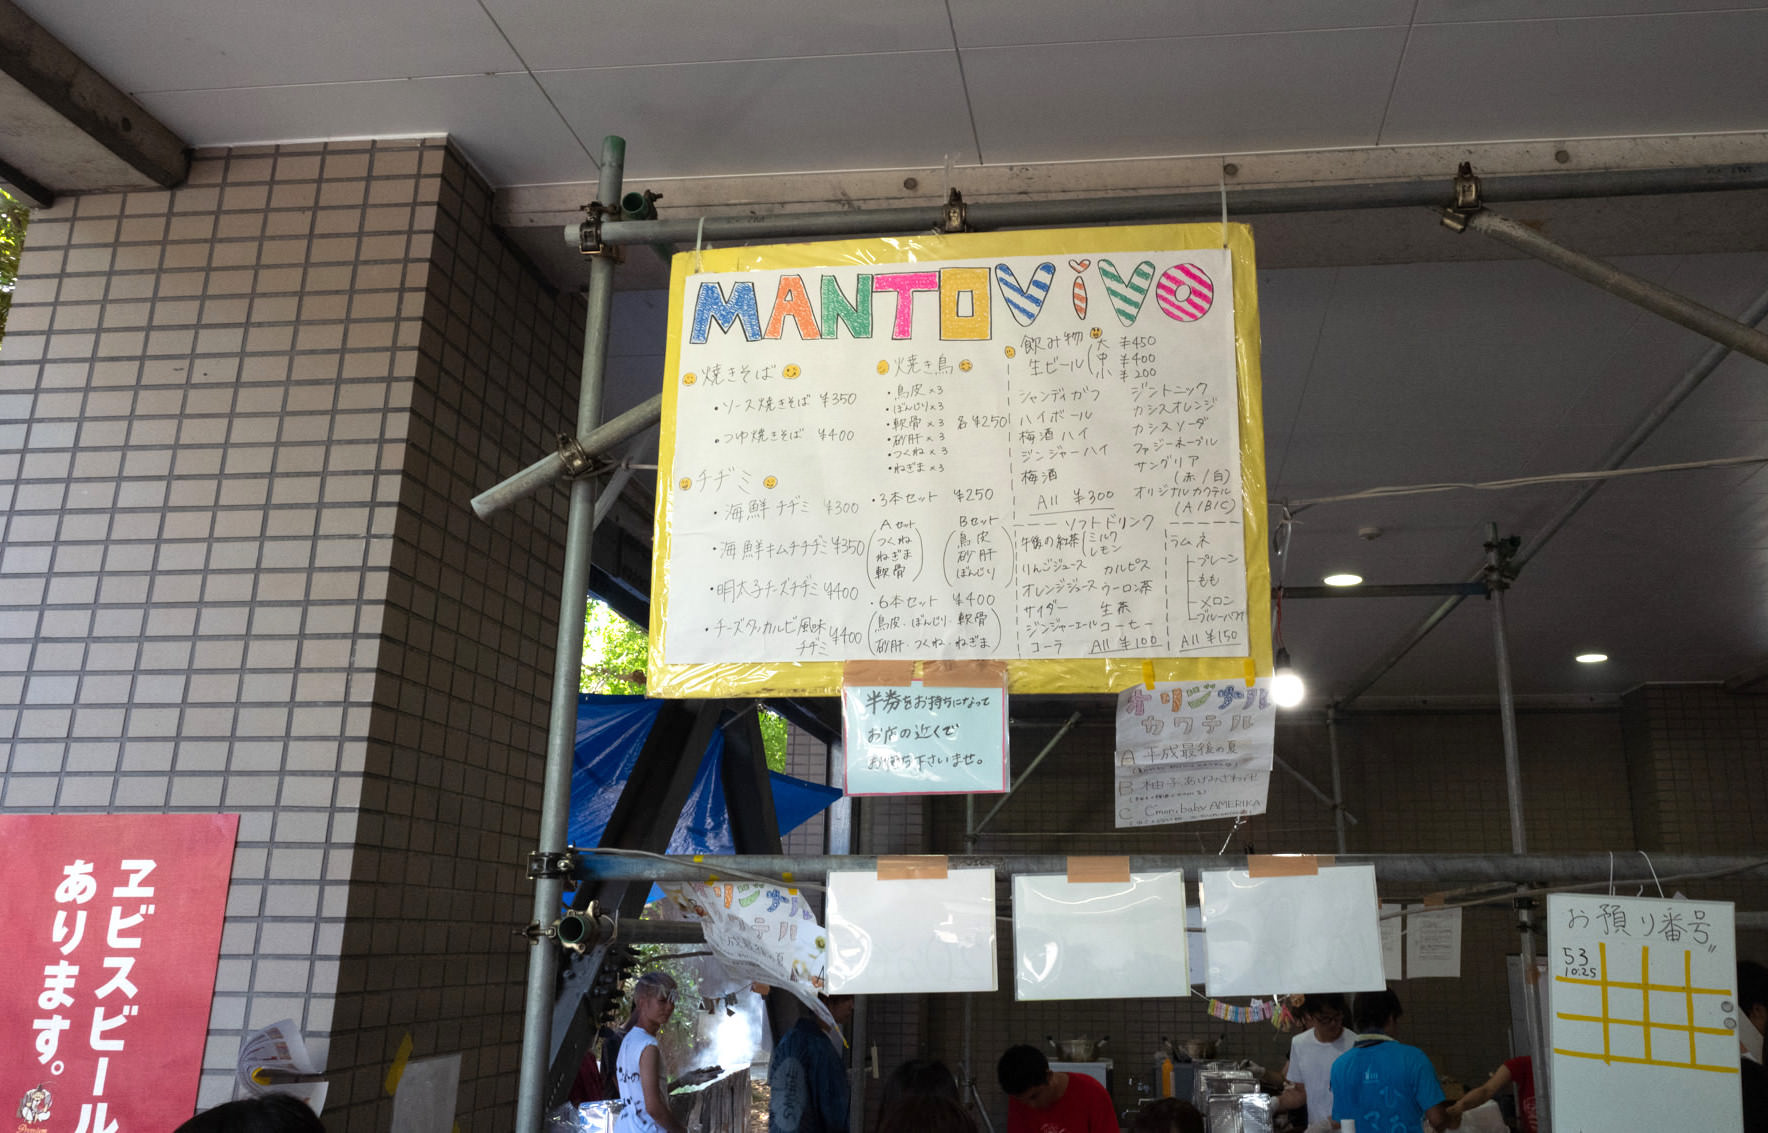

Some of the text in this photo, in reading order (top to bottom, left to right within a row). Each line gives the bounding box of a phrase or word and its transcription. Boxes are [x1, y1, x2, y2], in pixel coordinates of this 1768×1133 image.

[1021, 331, 1084, 355] 飲み物
[894, 354, 953, 376] 焼き鳥
[701, 364, 777, 385] 焼きそば
[820, 392, 857, 408] ¥350
[1131, 382, 1208, 401] ジントニック
[1134, 397, 1218, 417] カシスオレンジ
[1020, 410, 1093, 426] ハイボール
[1133, 417, 1209, 435] カシスソーダ
[818, 430, 854, 442] ¥400
[1021, 443, 1108, 463] ジンジャーハイ
[1135, 455, 1199, 473] サングリア
[1021, 468, 1058, 485] 梅酒
[954, 489, 994, 501] ¥250
[824, 498, 858, 515] ¥300
[1066, 513, 1154, 530] ソフトドリンク
[832, 536, 865, 556] ¥350
[1170, 532, 1210, 549] ラムネ
[1104, 559, 1151, 576] カルピス
[1197, 554, 1238, 567] プレーン
[1101, 580, 1153, 597] ウーロン茶
[1199, 573, 1220, 587] もも
[824, 582, 858, 600] ¥400
[953, 592, 995, 606] ¥400
[1023, 599, 1068, 617] サイダー
[1201, 596, 1235, 609] メロン
[829, 626, 862, 645] ¥400
[1205, 629, 1238, 644] ¥150
[1031, 640, 1064, 654] コーラ
[866, 689, 990, 715] 半券をお持ちになって
[1126, 683, 1271, 716] オリジナル
[1141, 714, 1254, 735] カクテル
[1563, 947, 1588, 966] 53
[32, 859, 97, 1075] あります。
